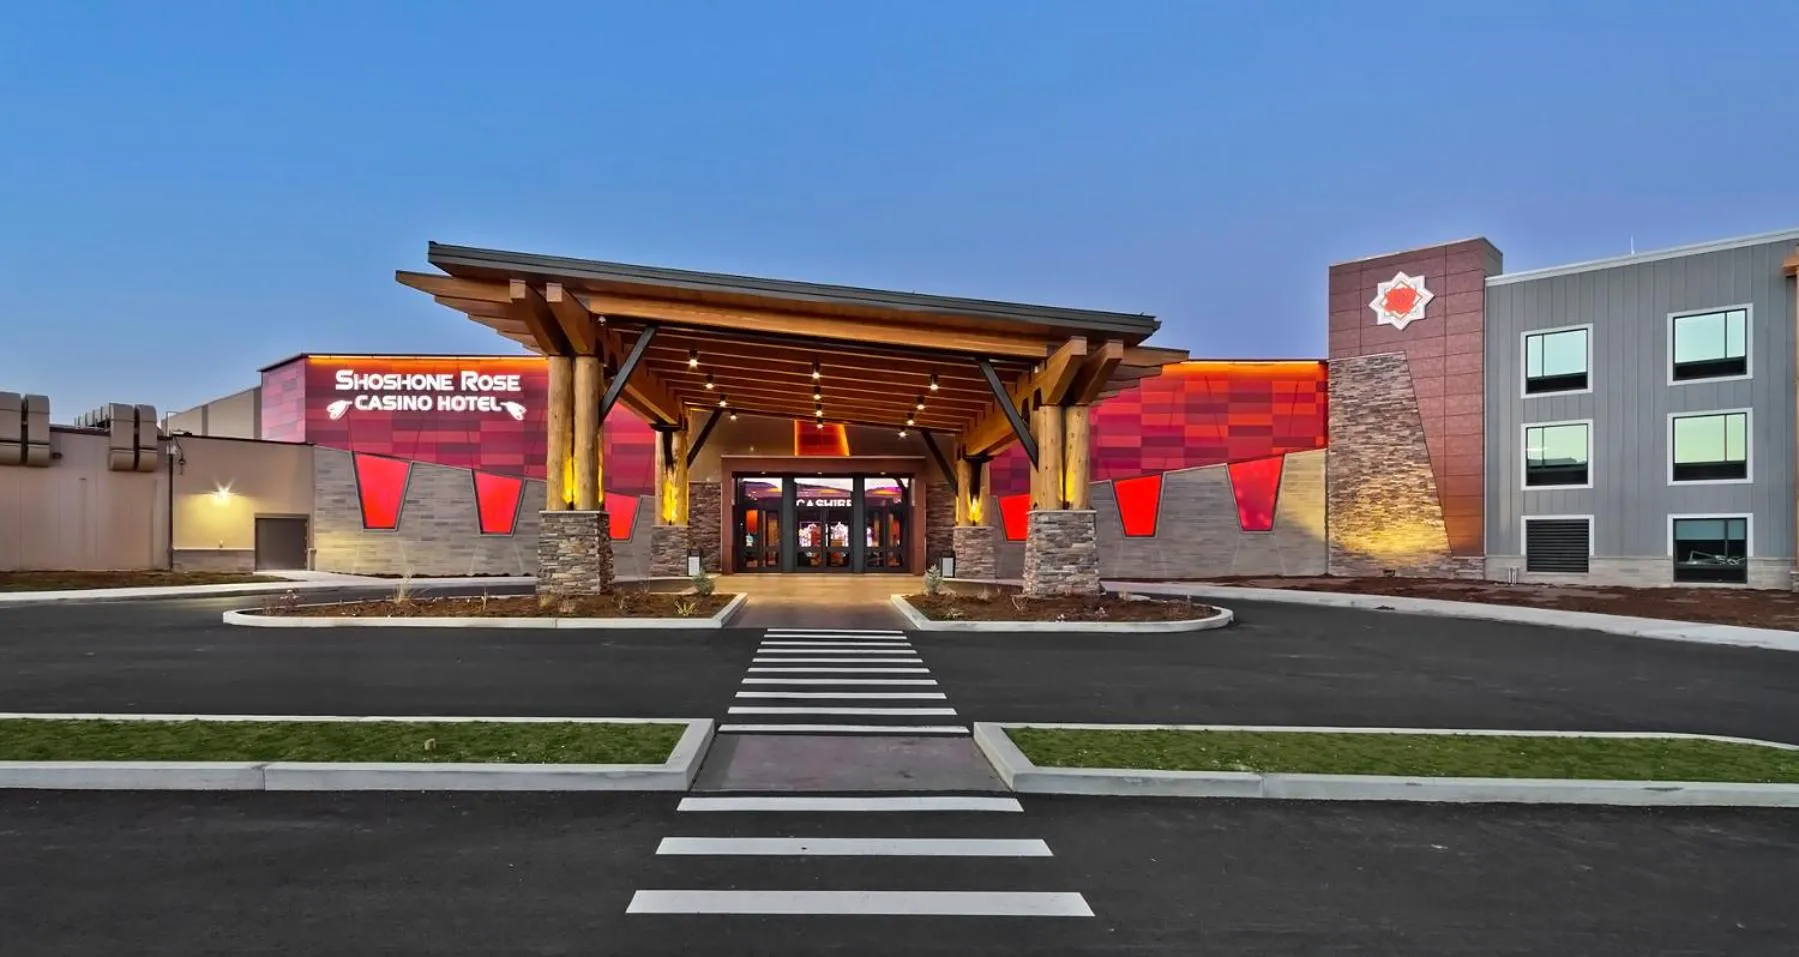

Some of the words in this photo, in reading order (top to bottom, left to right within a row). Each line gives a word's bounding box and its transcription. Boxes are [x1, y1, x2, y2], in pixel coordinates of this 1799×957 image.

[335, 369, 454, 391] SHOSHONE
[460, 370, 522, 392] ROSE
[354, 394, 433, 411] CASINO
[437, 395, 503, 412] HOTEL
